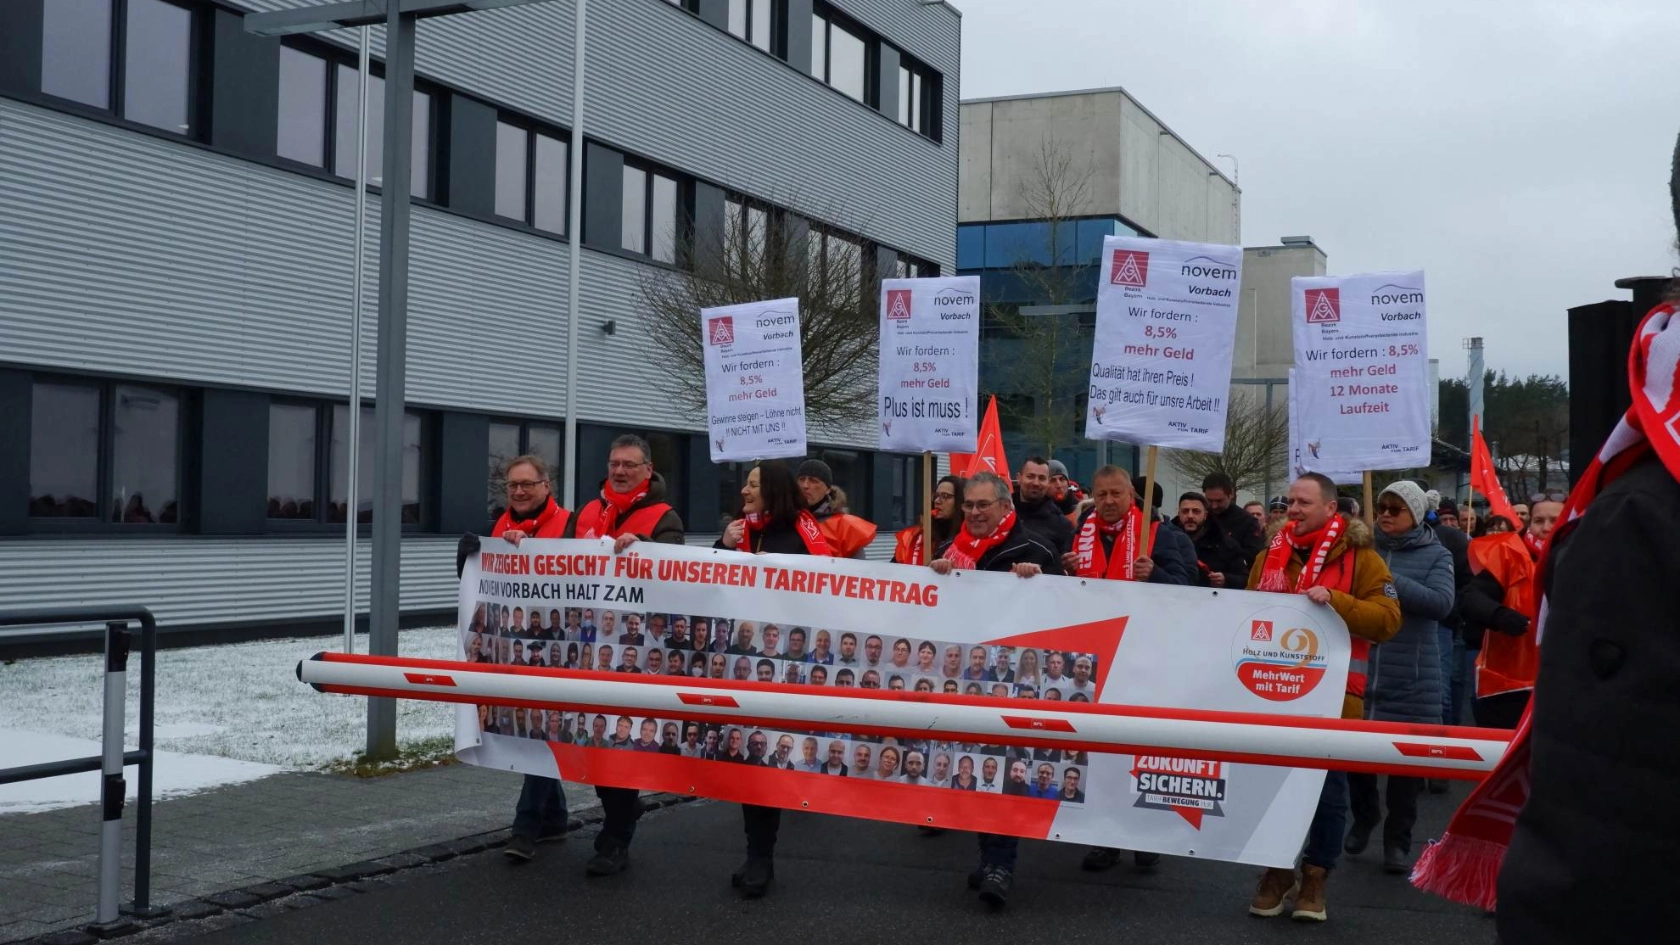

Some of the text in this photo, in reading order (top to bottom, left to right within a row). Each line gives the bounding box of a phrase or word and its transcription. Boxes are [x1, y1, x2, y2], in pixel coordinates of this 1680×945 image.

[1182, 265, 1236, 280] novem
[1189, 286, 1231, 297] Vorbach
[935, 294, 974, 306] novem
[1372, 292, 1423, 305] novem
[1129, 306, 1147, 317] Wir
[1151, 308, 1191, 322] fordern
[1381, 312, 1421, 321] Vorbach
[756, 316, 794, 328] novem
[763, 332, 794, 341] Vorbach
[1145, 325, 1177, 338] 8,5%
[897, 346, 912, 355] Wir
[915, 346, 949, 356] fordern
[1124, 344, 1194, 360] mehr Geld
[1306, 349, 1329, 361] Wir
[1332, 348, 1377, 360] fordern
[1388, 344, 1418, 357] 8,5%
[722, 363, 737, 373] Wir
[740, 360, 774, 371] fordern
[914, 362, 936, 373] 8,5%
[1330, 364, 1396, 378] mehr Geld
[740, 375, 763, 385] 8,5%
[1092, 363, 1125, 380] Qualität
[1127, 367, 1140, 382] hat
[1142, 368, 1163, 383] ihren
[1166, 371, 1189, 386] Preis
[901, 379, 950, 388] mehr Geld
[729, 388, 777, 402] mehr Geld
[1330, 384, 1398, 397] 12 Monate
[1090, 385, 1106, 400] Das
[1109, 388, 1121, 404] gilt
[1124, 390, 1144, 404] auch
[1147, 391, 1158, 405] für
[1161, 396, 1184, 408] unsre
[1186, 395, 1212, 411] Arbeit
[885, 396, 907, 417] Plus
[912, 397, 924, 418] ist
[929, 402, 960, 419] muss
[1340, 402, 1389, 414] Laufzeit
[712, 415, 736, 425] Gewinne
[738, 412, 758, 423] steigen
[766, 409, 784, 418] Löhne
[786, 406, 801, 416] nicht
[752, 424, 763, 434] MIT
[766, 423, 780, 432] UNS
[482, 551, 938, 607] WIR ZEIGEN GESICHT FÜR UNSEREN TARIFVERTRAG
[500, 581, 561, 600] VORBACH
[566, 583, 600, 601] HALT
[604, 585, 644, 603] ZAM
[1253, 670, 1305, 683] MehrWert
[1256, 683, 1300, 693] mit Tarif
[1137, 756, 1217, 775] ZUKUNFT
[1139, 774, 1222, 798] SICHERN.
